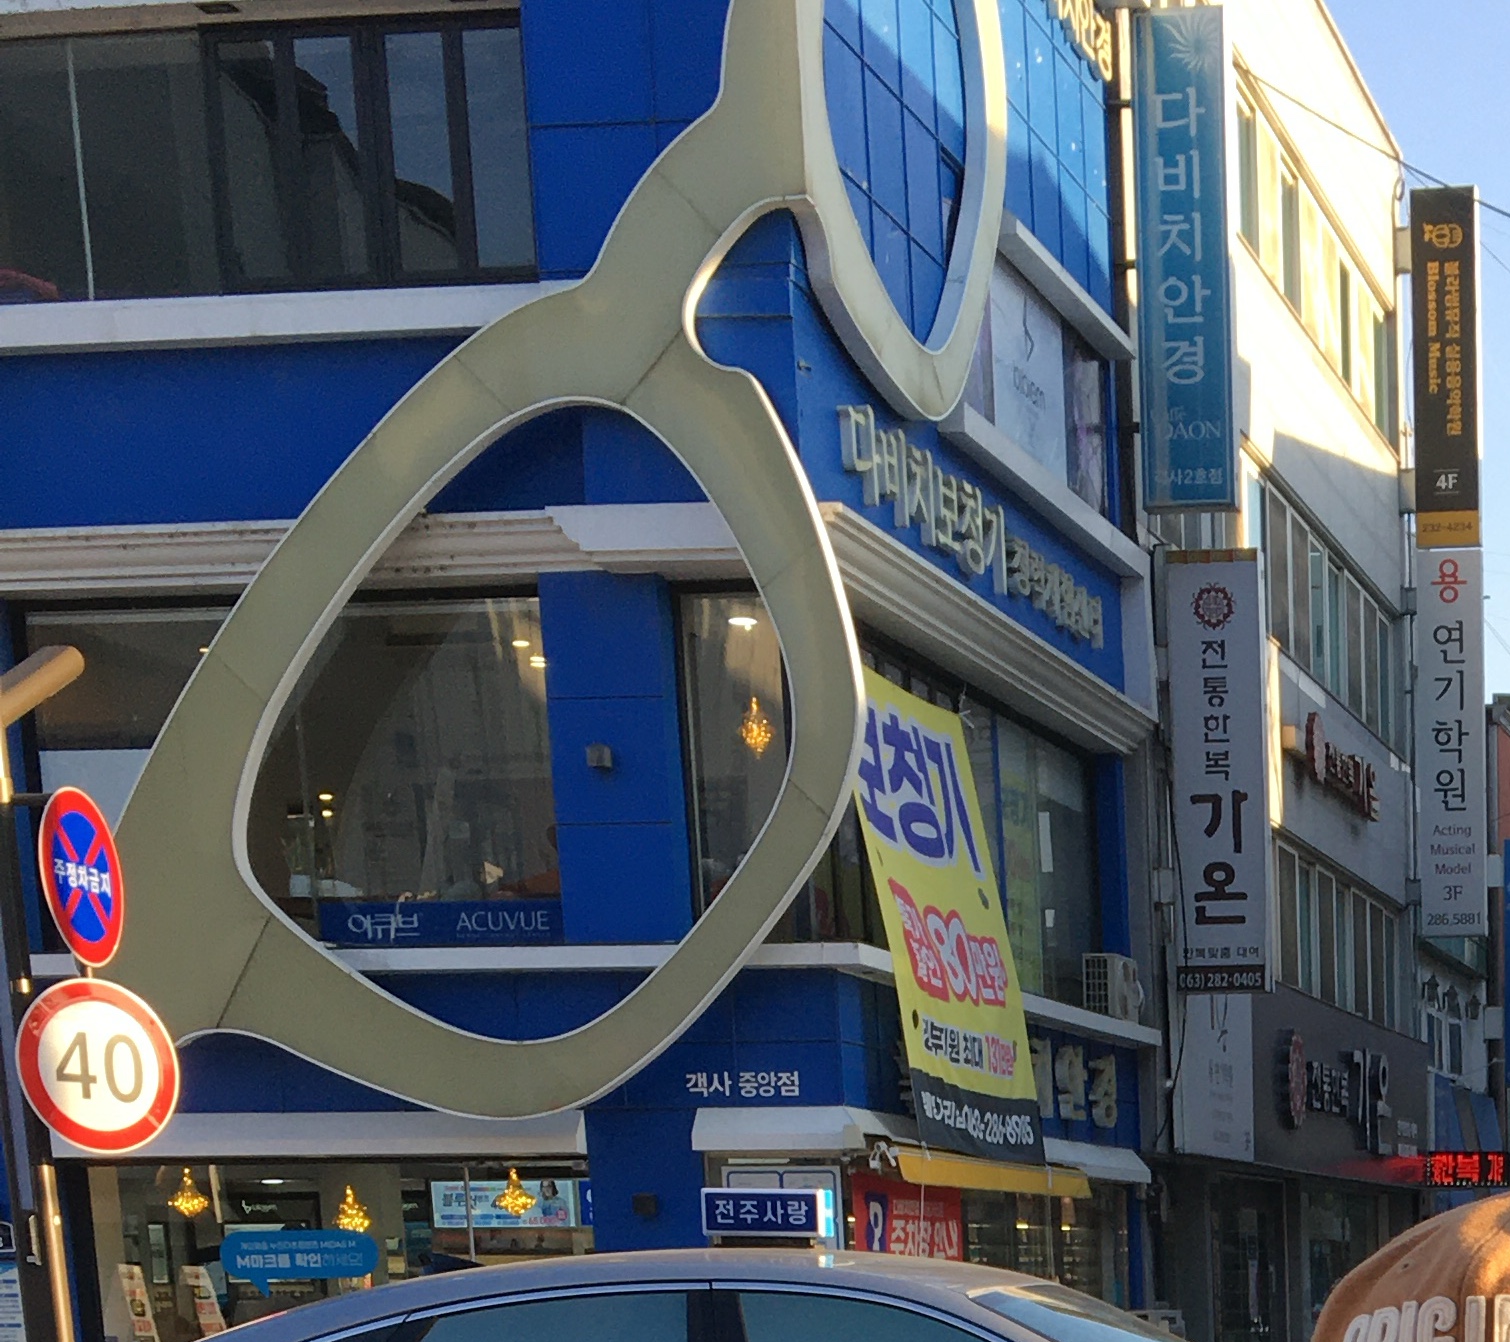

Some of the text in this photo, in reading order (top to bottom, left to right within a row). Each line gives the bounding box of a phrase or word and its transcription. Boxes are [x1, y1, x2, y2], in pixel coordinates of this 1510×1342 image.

[1152, 86, 1212, 385] 다비치안경
[1426, 261, 1441, 394] Blossom Music
[1435, 473, 1458, 491] 4F
[836, 403, 1008, 596] 다비치보청기
[1431, 557, 1470, 812] 용 연기학원
[1190, 638, 1249, 926] 전통한복 가온
[1432, 822, 1472, 839] Acting
[1430, 841, 1476, 857] Musical
[54, 858, 113, 899] 주정차금지
[1434, 861, 1472, 876] Model
[1443, 885, 1464, 901] 3F
[347, 913, 421, 940] 아큐브
[456, 910, 551, 932] ACUVUE
[56, 1031, 144, 1104] 40
[685, 1070, 800, 1098] 객사 중앙점
[714, 1199, 809, 1226] 전주사랑
[236, 1253, 291, 1269] M마크를
